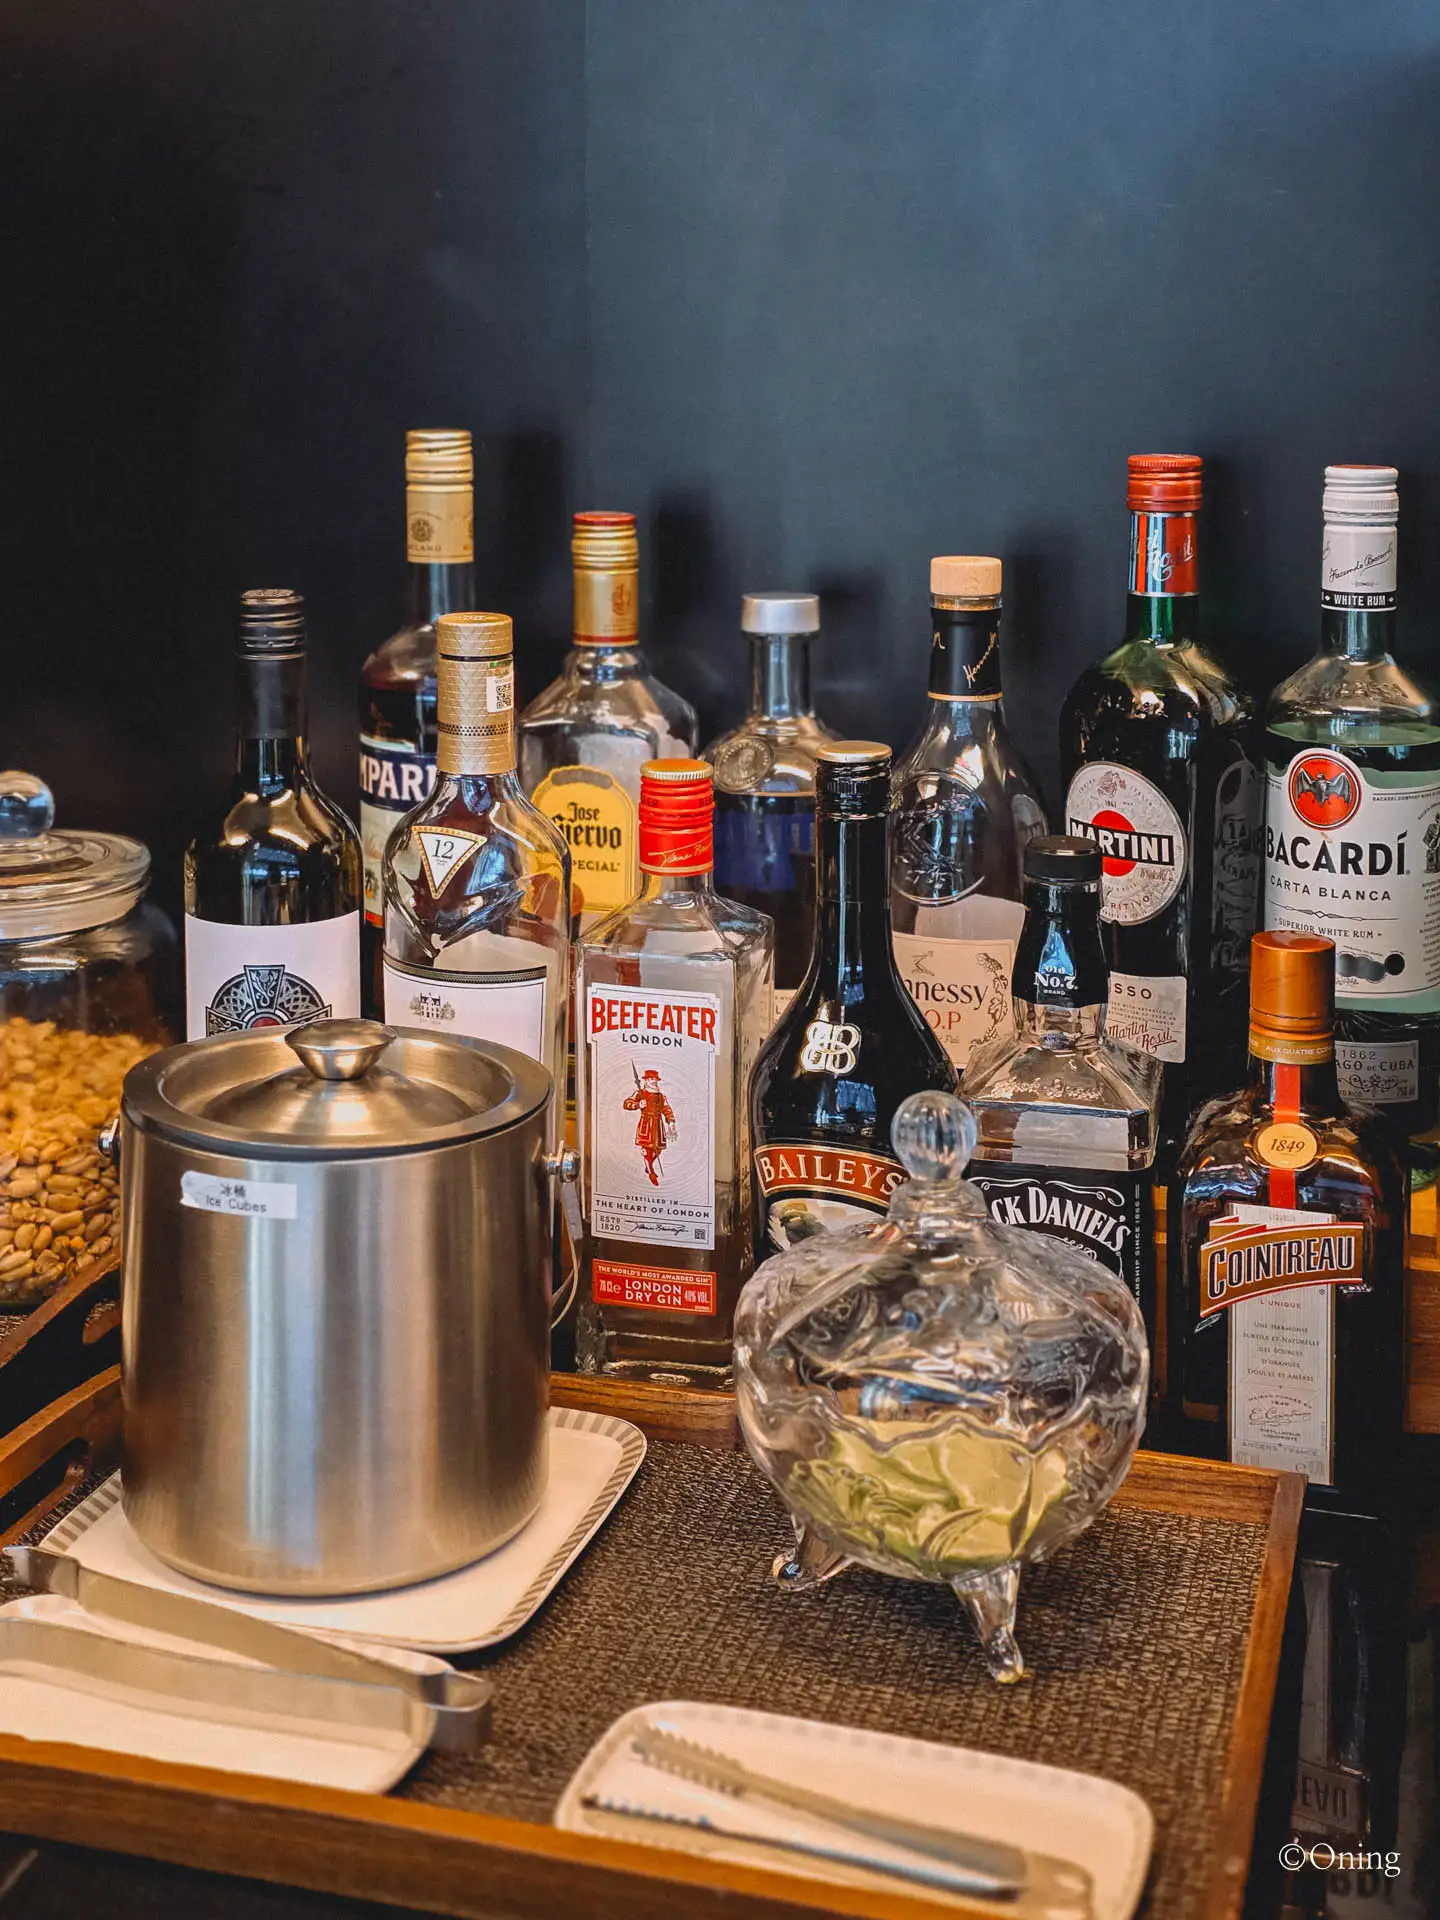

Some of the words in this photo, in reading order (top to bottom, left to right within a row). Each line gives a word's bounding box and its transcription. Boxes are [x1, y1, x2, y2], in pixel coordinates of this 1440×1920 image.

[1334, 594, 1364, 606] WHITE
[1367, 595, 1386, 606] RUM
[567, 801, 601, 823] Jose
[432, 839, 455, 860] 12
[1071, 821, 1170, 863] MARTINI
[1266, 825, 1408, 876] BACARDÍ
[572, 860, 618, 872] ECIAL
[1271, 874, 1311, 896] CARTA
[1319, 887, 1392, 902] BLANCA
[1278, 916, 1316, 934] SUPERIOR
[1318, 926, 1350, 938] WHITE
[1352, 929, 1374, 939] RUM
[1045, 965, 1066, 975] Old
[592, 997, 716, 1046] BEEFEATER
[622, 1033, 683, 1048] LONDON
[1342, 1049, 1377, 1060] 1862
[1379, 1060, 1415, 1072] CUBA
[1270, 1138, 1305, 1153] 1849
[760, 1153, 903, 1196] BAILEYS
[205, 1195, 222, 1207] Ice
[228, 1197, 268, 1213] Cubes
[625, 1195, 666, 1205] DISTILLED
[596, 1200, 613, 1209] THE
[617, 1202, 648, 1213] HEART
[667, 1208, 710, 1219] LONDON
[600, 1223, 621, 1232] 1820
[1027, 1186, 1132, 1253] DANIEL'S
[598, 1265, 611, 1273] THE
[612, 1267, 641, 1277] WORLD'S
[642, 1271, 660, 1279] MOST
[661, 1273, 694, 1282] AWARDED
[1208, 1236, 1355, 1300] COINTREAU
[625, 1279, 682, 1295] LONDON
[625, 1290, 653, 1302] DRY
[657, 1294, 682, 1305] GIN
